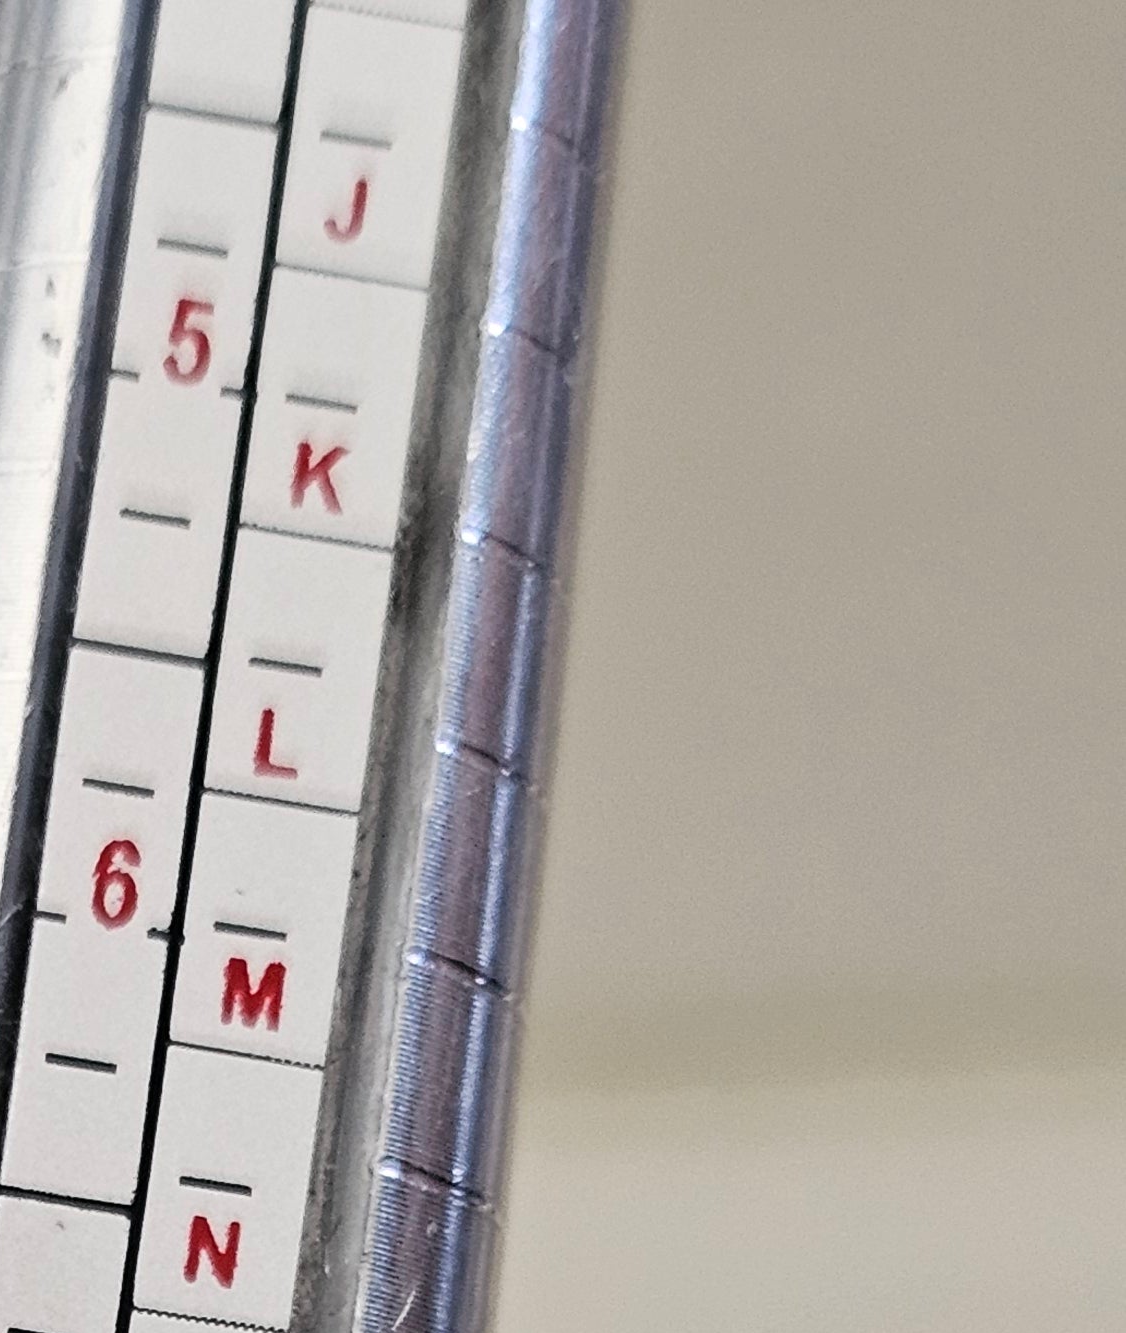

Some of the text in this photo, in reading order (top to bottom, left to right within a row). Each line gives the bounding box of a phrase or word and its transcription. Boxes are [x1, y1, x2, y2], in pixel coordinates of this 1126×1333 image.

[327, 179, 369, 239] J
[167, 298, 210, 378] 5
[293, 442, 343, 506] K
[254, 708, 294, 776] L
[94, 840, 138, 924] 6
[224, 958, 285, 1024] M
[185, 1216, 240, 1285] N
